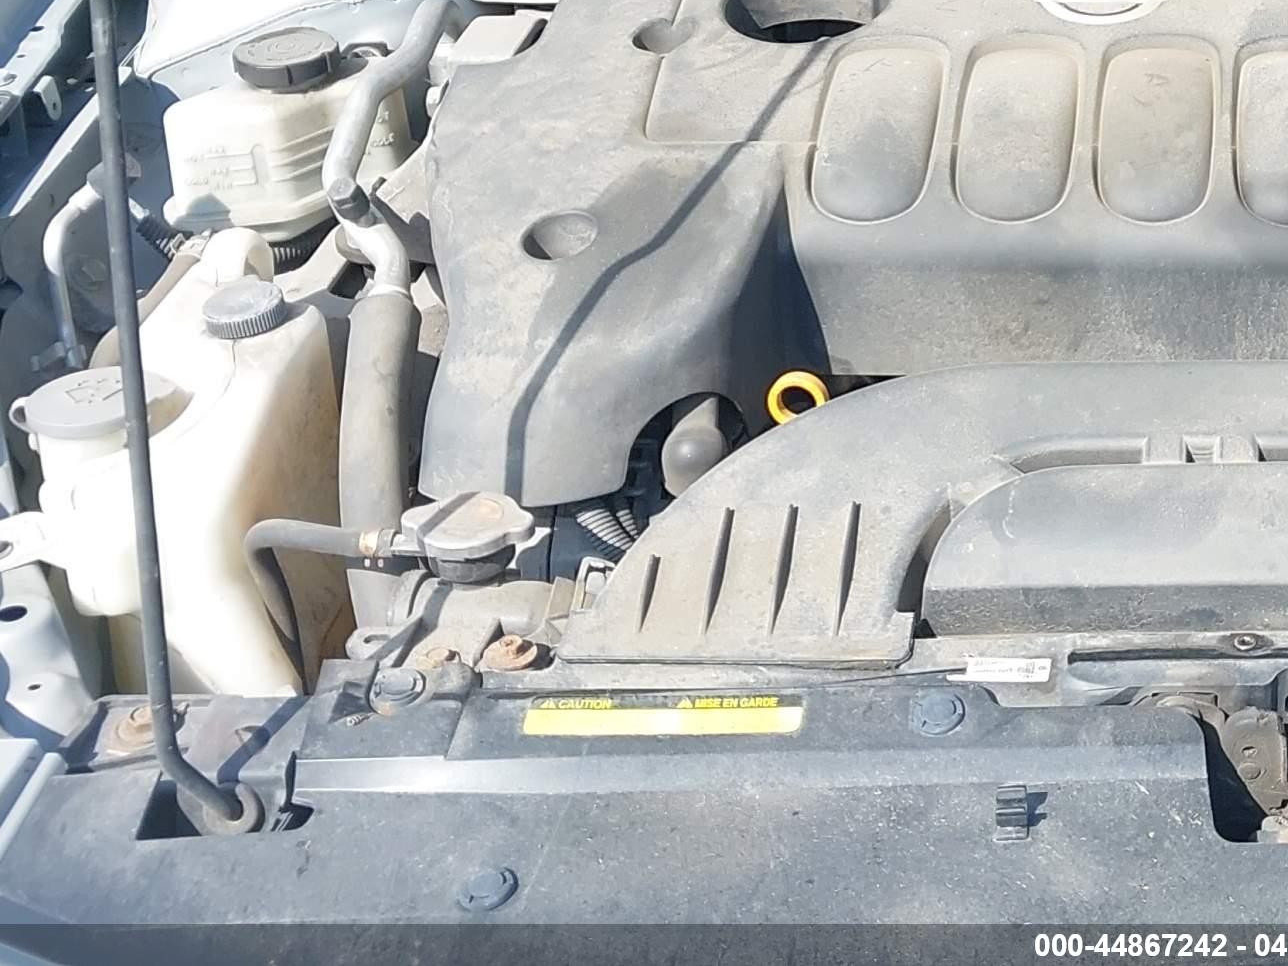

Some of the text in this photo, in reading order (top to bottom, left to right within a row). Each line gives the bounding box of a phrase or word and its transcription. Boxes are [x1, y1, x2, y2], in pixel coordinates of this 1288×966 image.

[557, 698, 612, 710] CAUTION
[694, 696, 778, 709] MISE EN GARDE
